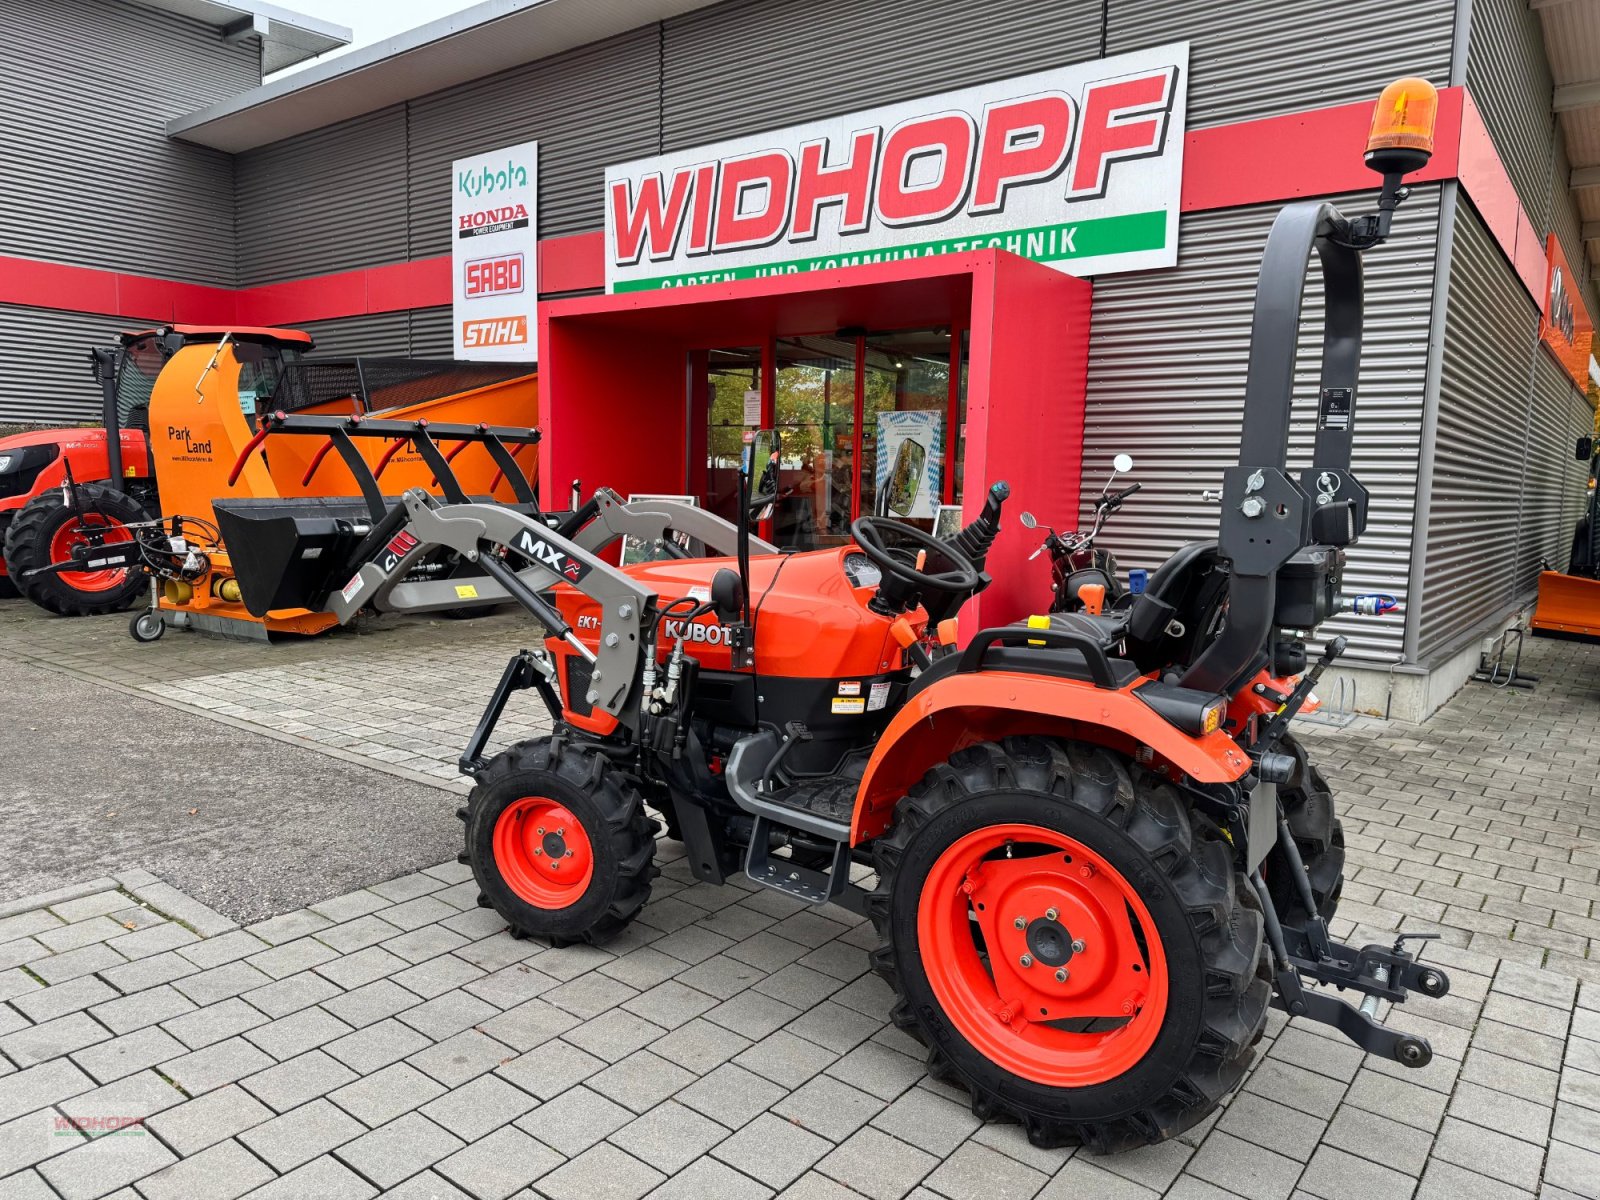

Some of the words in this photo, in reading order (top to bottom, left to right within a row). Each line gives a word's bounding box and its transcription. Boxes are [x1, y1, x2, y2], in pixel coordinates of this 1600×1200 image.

[459, 160, 526, 198] Kubota
[609, 66, 1177, 266] WIDHOPF
[459, 204, 529, 229] HONDA
[473, 226, 489, 236] POWER
[489, 221, 515, 233] EQUIPMENT
[467, 258, 522, 295] SABO
[464, 319, 524, 346] STIHL
[168, 426, 191, 440] Park
[187, 440, 212, 453] Land
[520, 531, 566, 571] MX
[577, 615, 601, 630] EK1-
[665, 619, 733, 646] KUBOT
